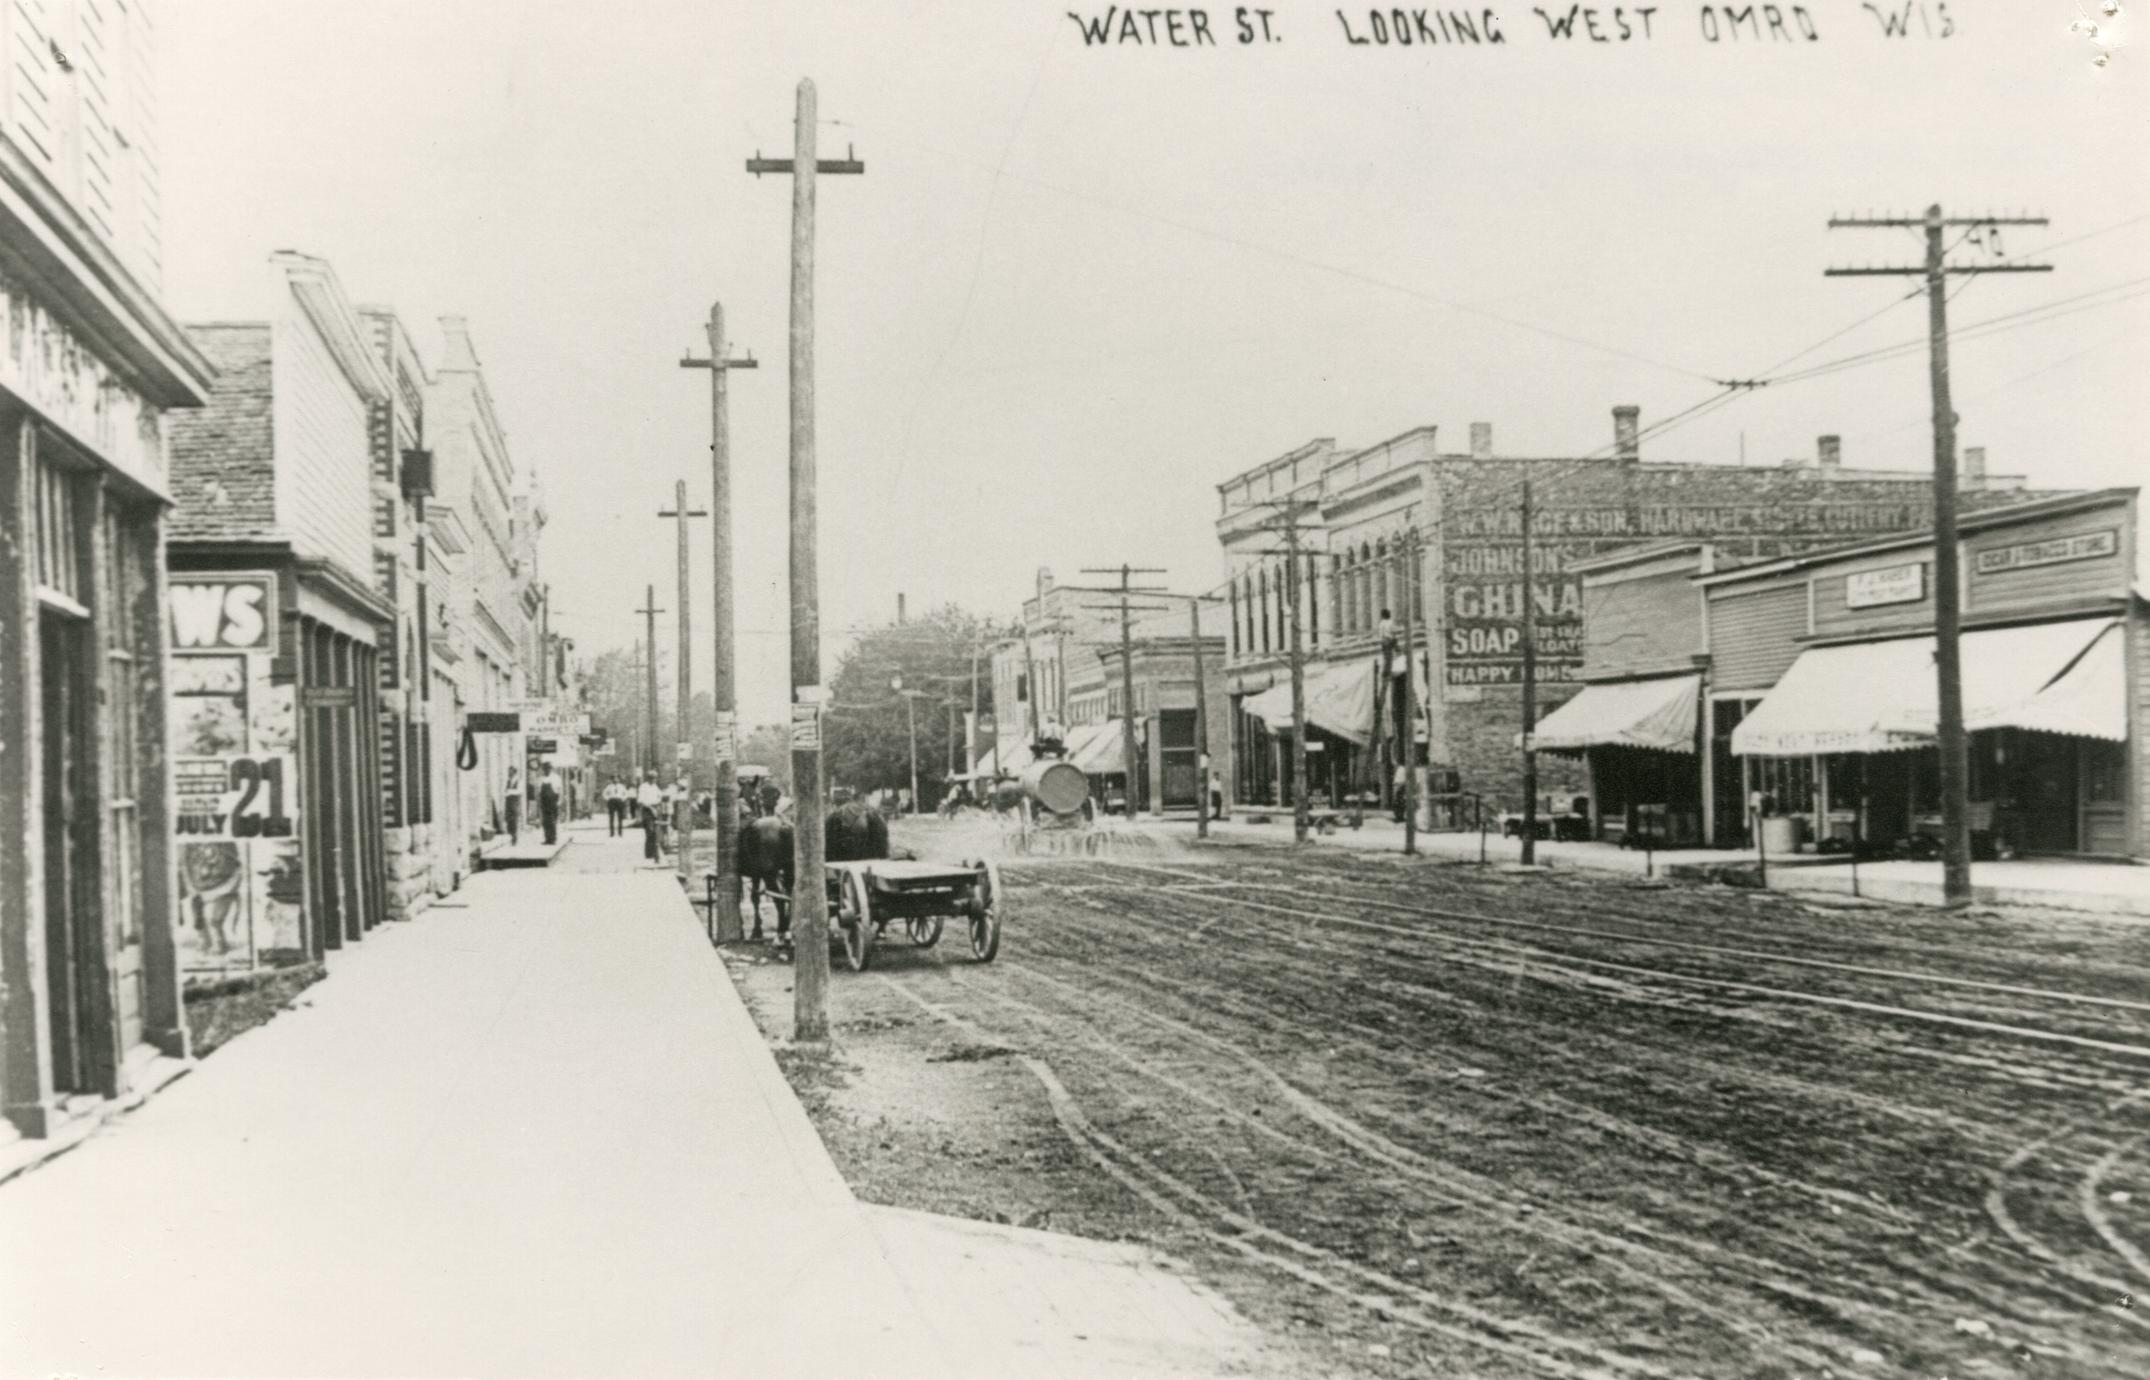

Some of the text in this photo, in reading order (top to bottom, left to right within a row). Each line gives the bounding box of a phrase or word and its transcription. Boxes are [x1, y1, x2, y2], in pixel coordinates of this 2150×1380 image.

[1453, 583, 1584, 620] CHINA
[1451, 664, 1514, 684] HAPPY
[175, 757, 292, 838] JULY 21
